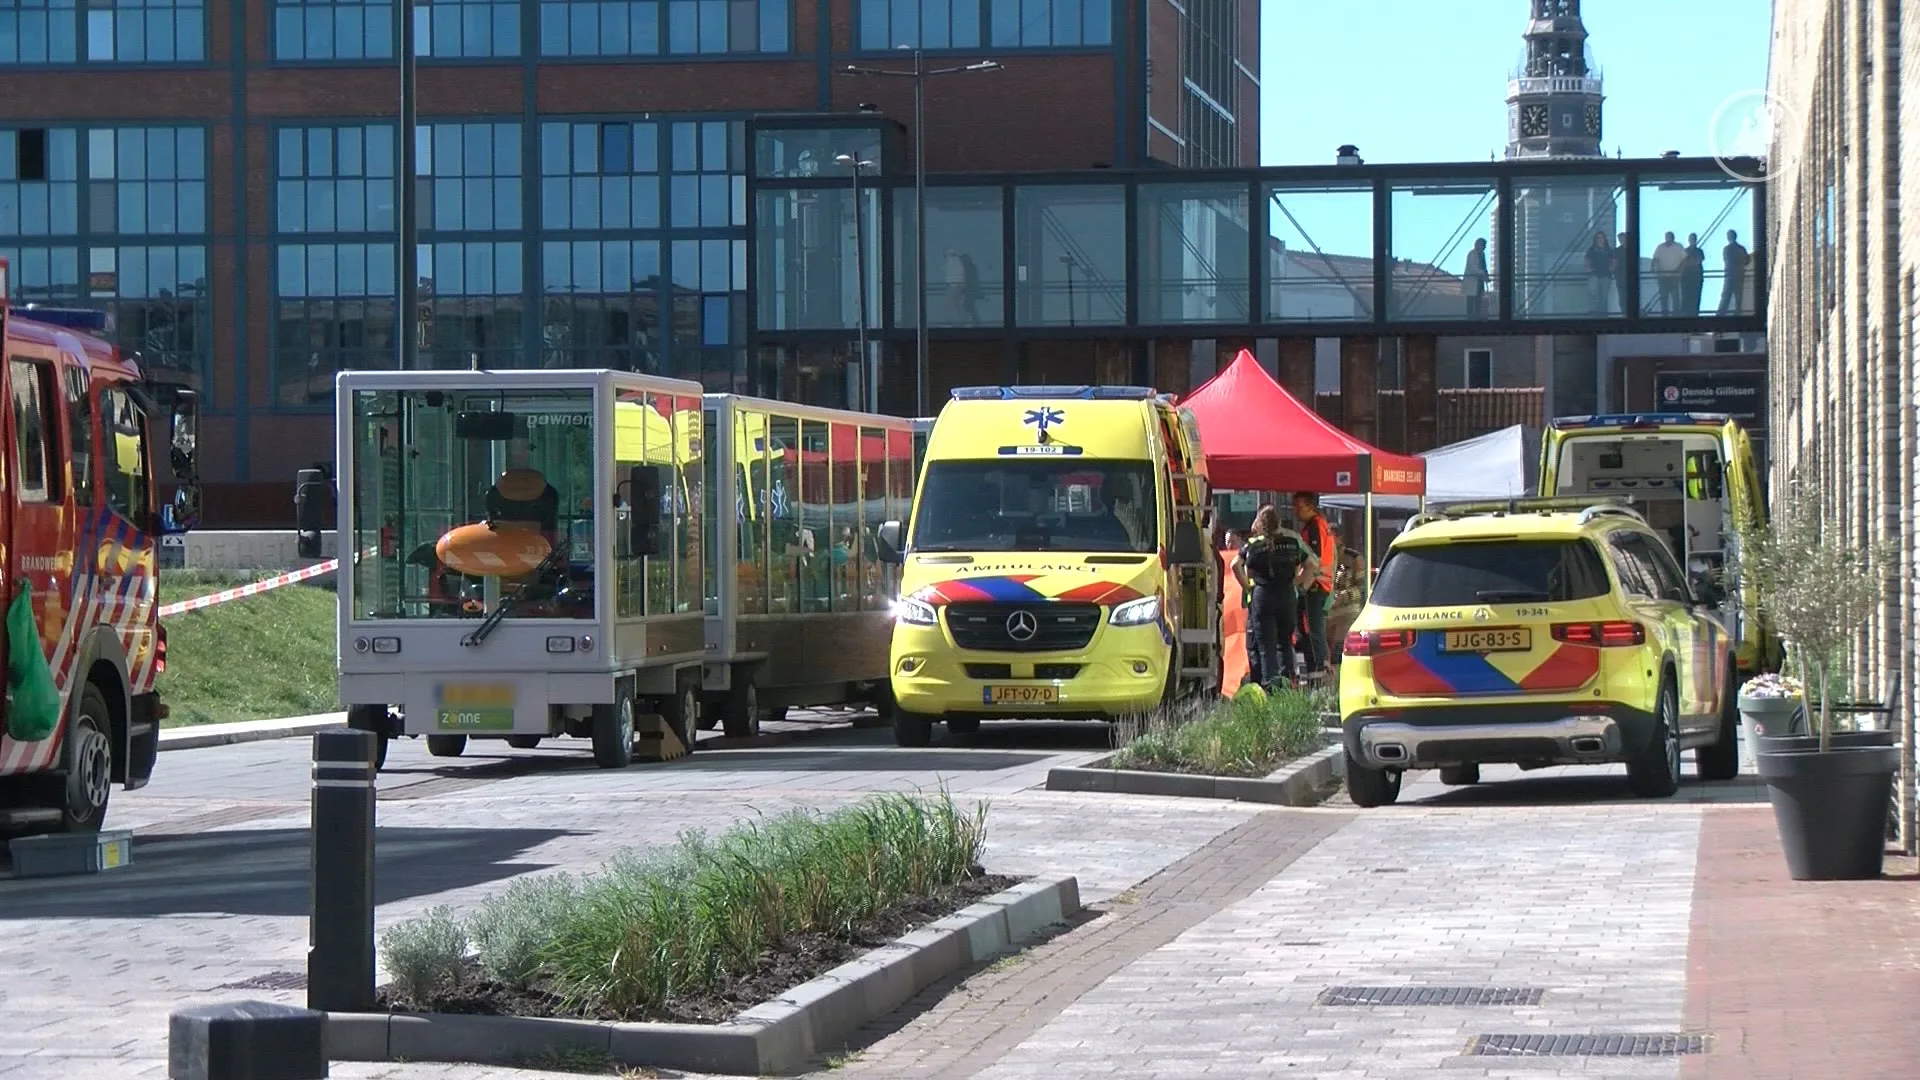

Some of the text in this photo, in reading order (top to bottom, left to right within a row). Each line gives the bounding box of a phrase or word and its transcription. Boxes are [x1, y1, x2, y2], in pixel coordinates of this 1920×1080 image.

[1682, 387, 1755, 396] Dennis Gillissen
[21, 555, 64, 571] BRANDWE
[956, 564, 1102, 573] AMBULANCE
[1393, 611, 1463, 622] AMBULANCE
[1516, 608, 1549, 617] 19-341
[1452, 632, 1521, 648] JJG-83-S
[997, 688, 1052, 700] JFT-07-D
